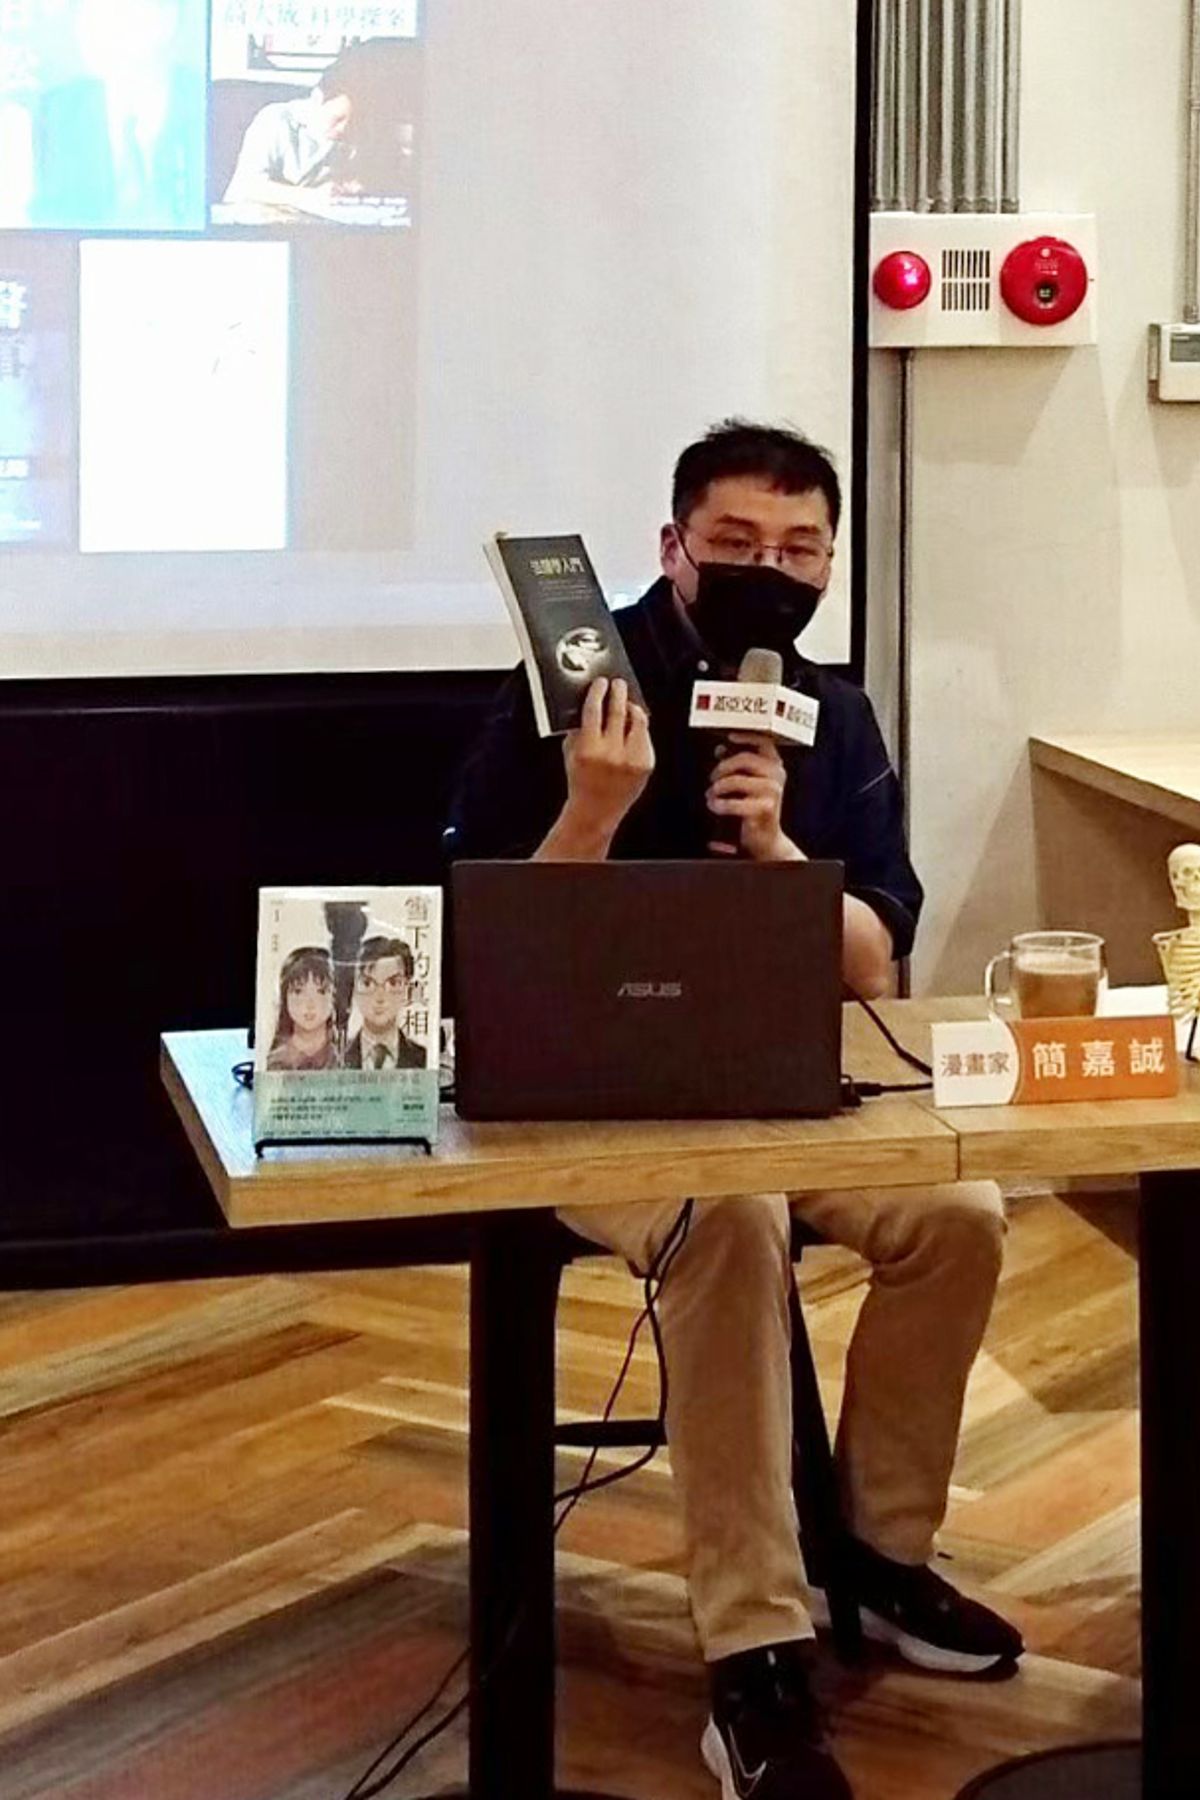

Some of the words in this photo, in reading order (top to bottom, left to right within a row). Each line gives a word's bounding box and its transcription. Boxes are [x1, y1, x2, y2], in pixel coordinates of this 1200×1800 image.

[616, 981, 683, 998] ASUS
[940, 1050, 1011, 1078] 漫畫家
[1031, 1037, 1167, 1081] 簡嘉誠
